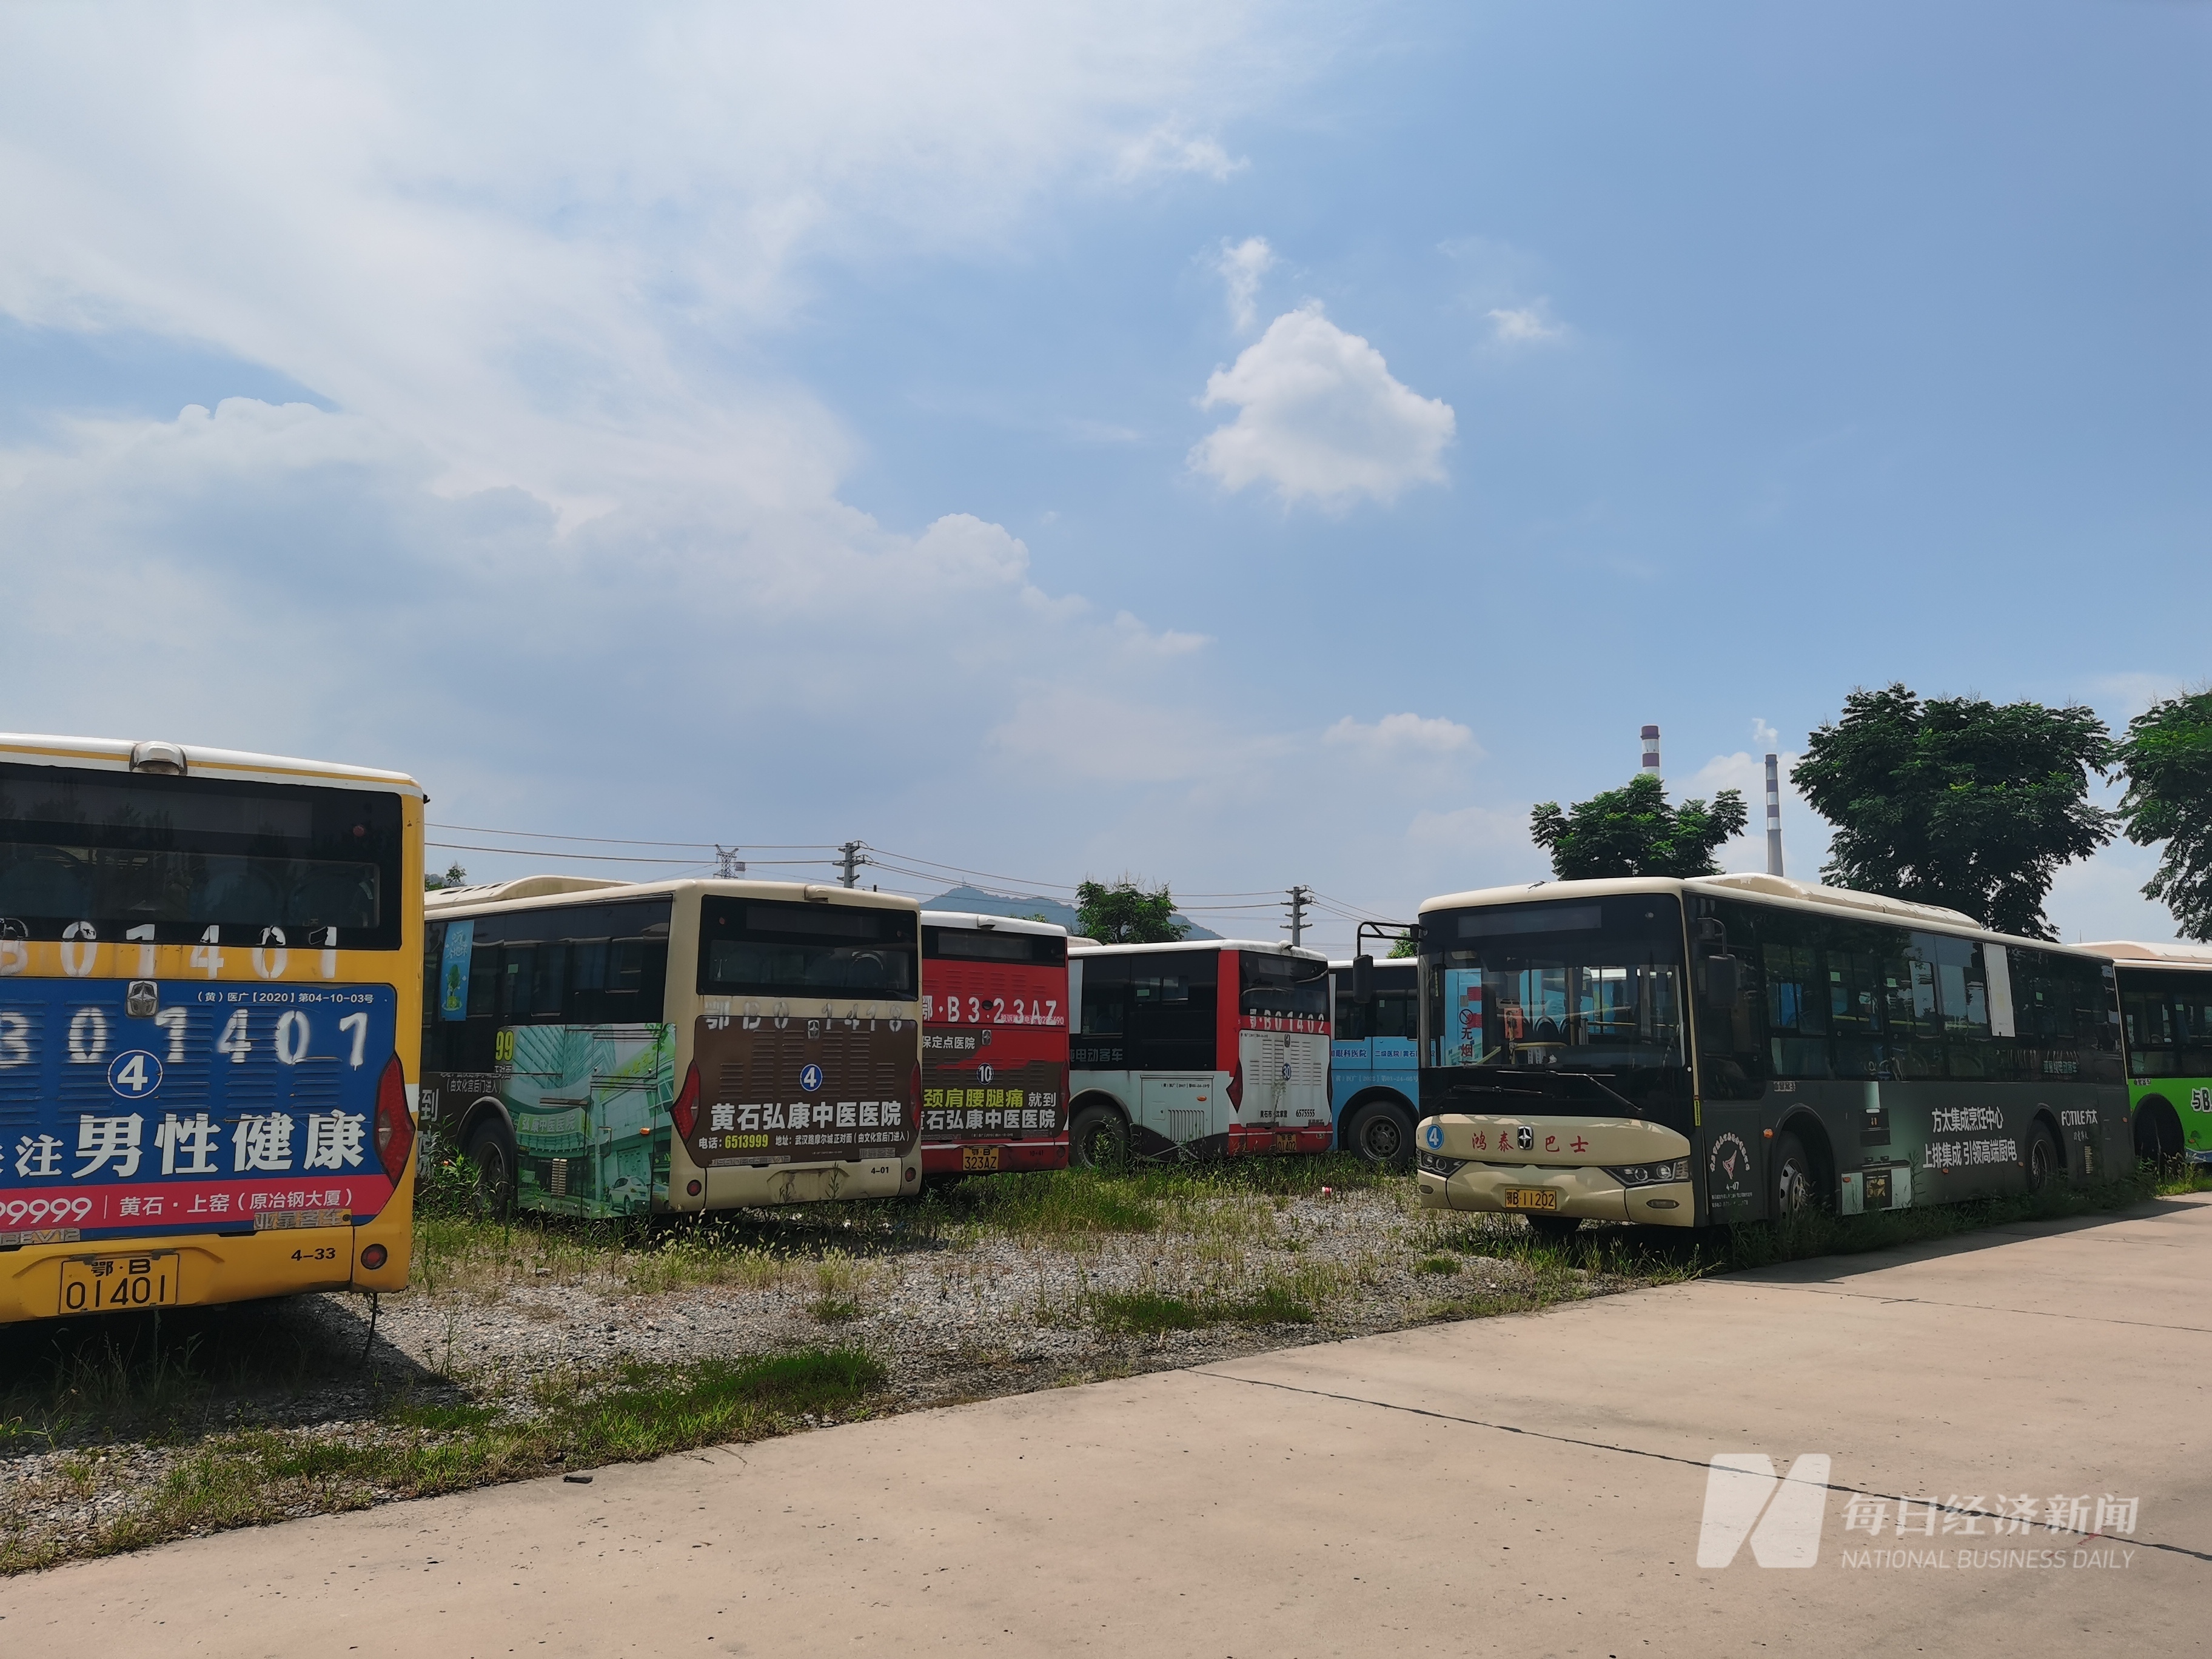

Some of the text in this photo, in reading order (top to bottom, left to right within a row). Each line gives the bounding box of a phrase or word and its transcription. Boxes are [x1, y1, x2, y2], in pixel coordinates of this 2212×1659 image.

[495, 1031, 514, 1061] 99
[1461, 1027, 1473, 1065] 无烟
[118, 1056, 148, 1091] 4
[804, 1067, 817, 1087] 4
[979, 1065, 991, 1083] 10
[1282, 1066, 1291, 1080] 30
[923, 1088, 1056, 1108] 颈肩腰腿痛 就到
[710, 1101, 902, 1133] 黄石弘康中医医院
[921, 1109, 1056, 1130] 石弘康中医医院
[1932, 1106, 2004, 1133] 方太集成烹饪中心
[72, 1109, 366, 1179] 男性健康
[1429, 1128, 1439, 1146] 4
[964, 1156, 997, 1169] 323AZ
[1923, 1141, 1962, 1169] 上排集成
[871, 1166, 890, 1175] 4-01
[0, 1228, 81, 1245] BEV12
[290, 1247, 337, 1261] 4-33
[66, 1275, 166, 1310] 01401
